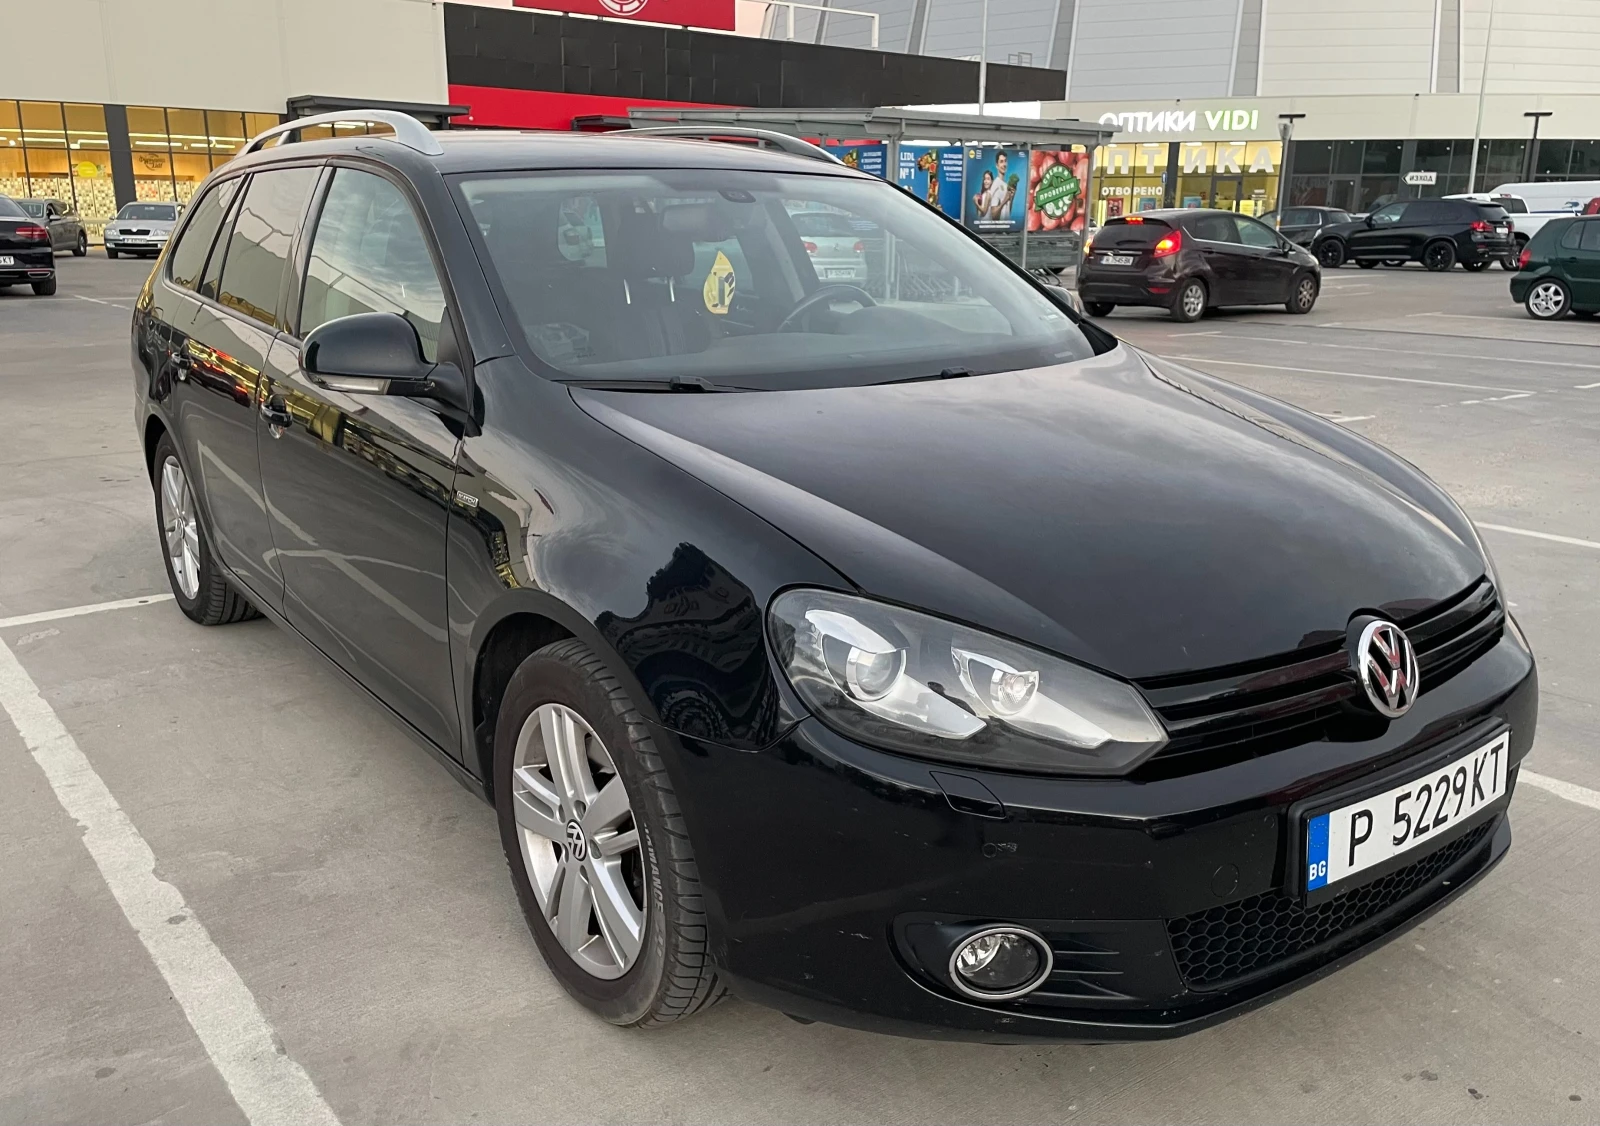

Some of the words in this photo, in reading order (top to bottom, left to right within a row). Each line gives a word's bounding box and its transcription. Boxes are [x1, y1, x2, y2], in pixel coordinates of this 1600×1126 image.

[1100, 110, 1196, 132] ОПТИКИ
[1204, 109, 1259, 131] VIDI
[1093, 147, 1274, 175] ПТИКА
[1040, 182, 1075, 201] ПРОВЕРЕНИ
[1348, 808, 1374, 868] P
[1309, 860, 1327, 882] BG
